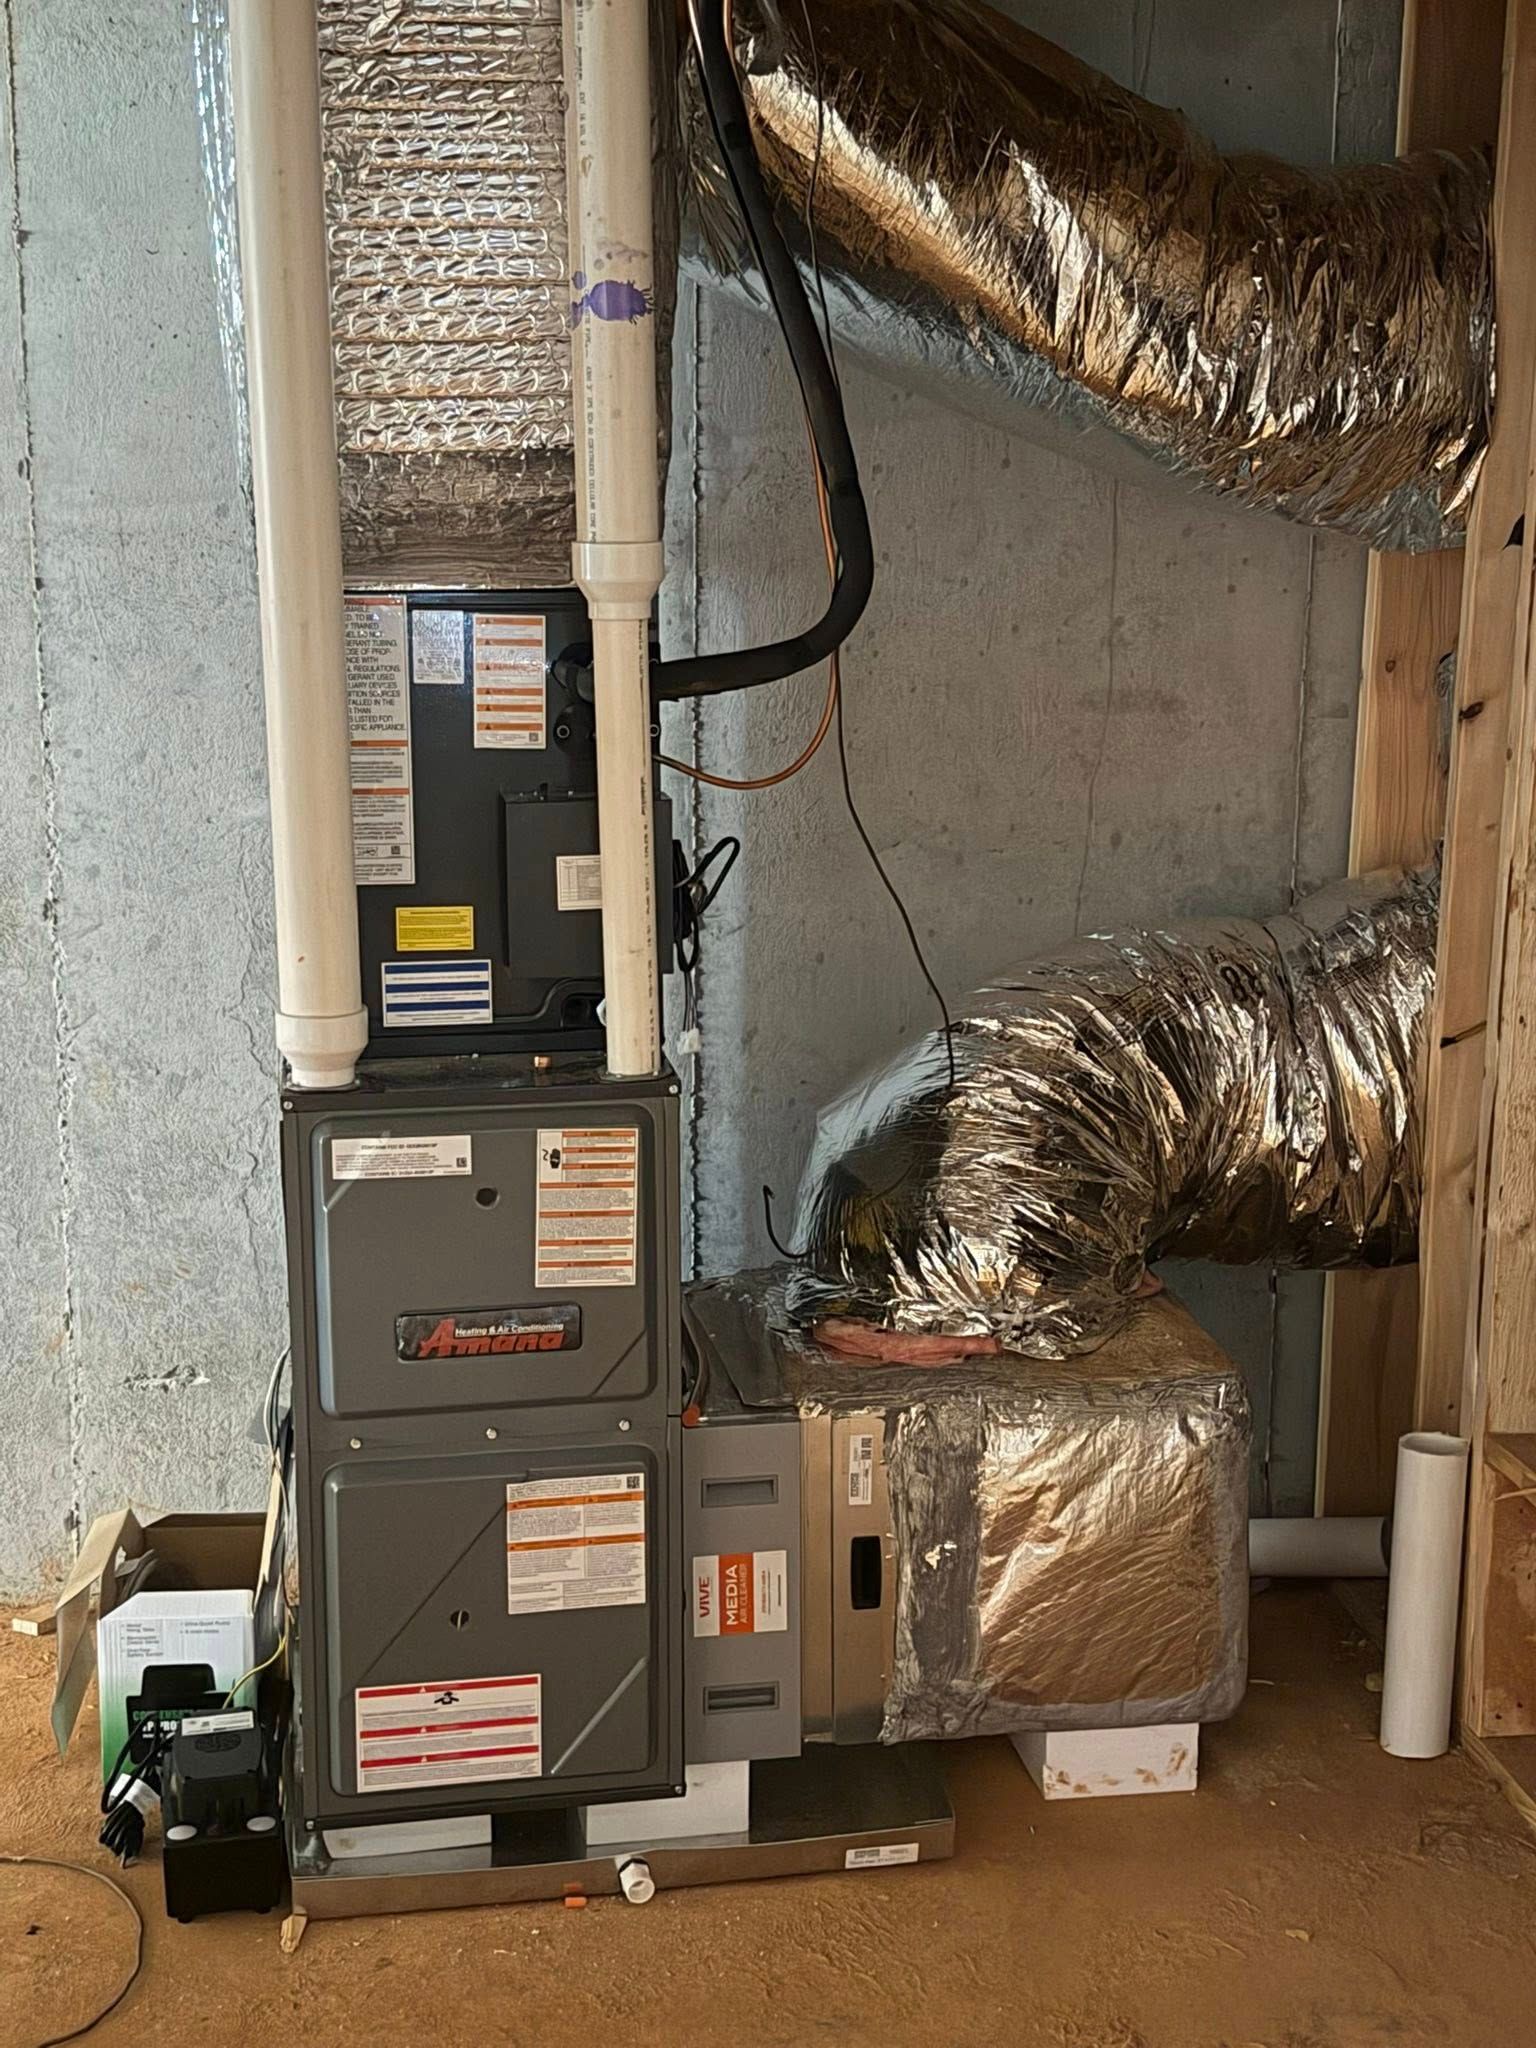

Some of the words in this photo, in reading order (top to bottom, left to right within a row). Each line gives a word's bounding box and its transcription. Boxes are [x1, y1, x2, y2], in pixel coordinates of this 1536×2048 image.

[417, 1318, 565, 1358] Amana
[455, 1327, 487, 1337] Heating
[488, 1327, 495, 1335] &
[497, 1325, 511, 1335] Air
[511, 1322, 564, 1334] Conditioning
[699, 1576, 710, 1618] VIVE
[726, 1564, 738, 1625] MEDIA
[739, 1563, 748, 1606] CLEANER
[740, 1608, 748, 1624] AIR
